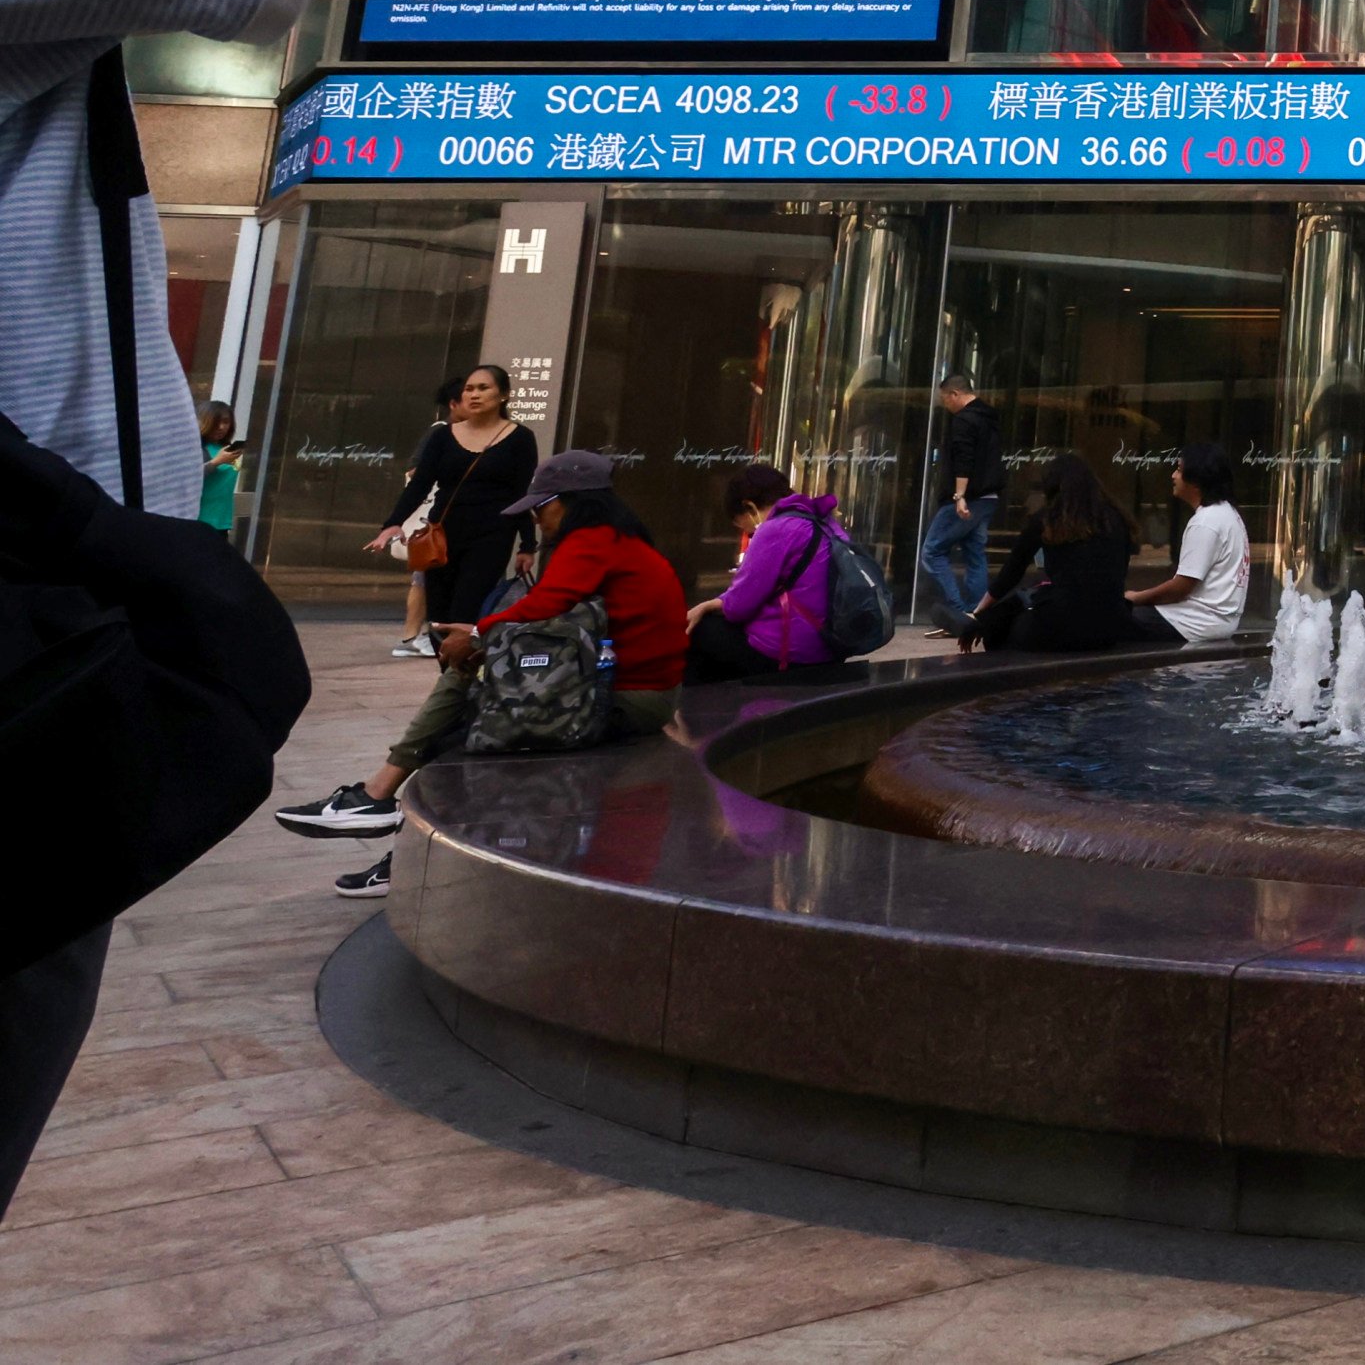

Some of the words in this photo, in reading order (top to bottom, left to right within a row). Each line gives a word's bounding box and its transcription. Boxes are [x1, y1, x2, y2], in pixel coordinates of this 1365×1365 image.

[321, 82, 516, 119] 國企業指數
[545, 86, 661, 113] SCCEA
[676, 86, 798, 113] 4098.23
[849, 85, 927, 114] -33.8
[989, 82, 1350, 120] 標普香港創業板指數
[440, 137, 534, 165] 00066
[547, 133, 705, 170] 港鐵公司
[724, 138, 796, 164] MTR
[806, 137, 1059, 165] CORPORATION
[1081, 137, 1167, 165] 36.66
[1205, 137, 1285, 166] -0.08
[511, 411, 545, 422] Square
